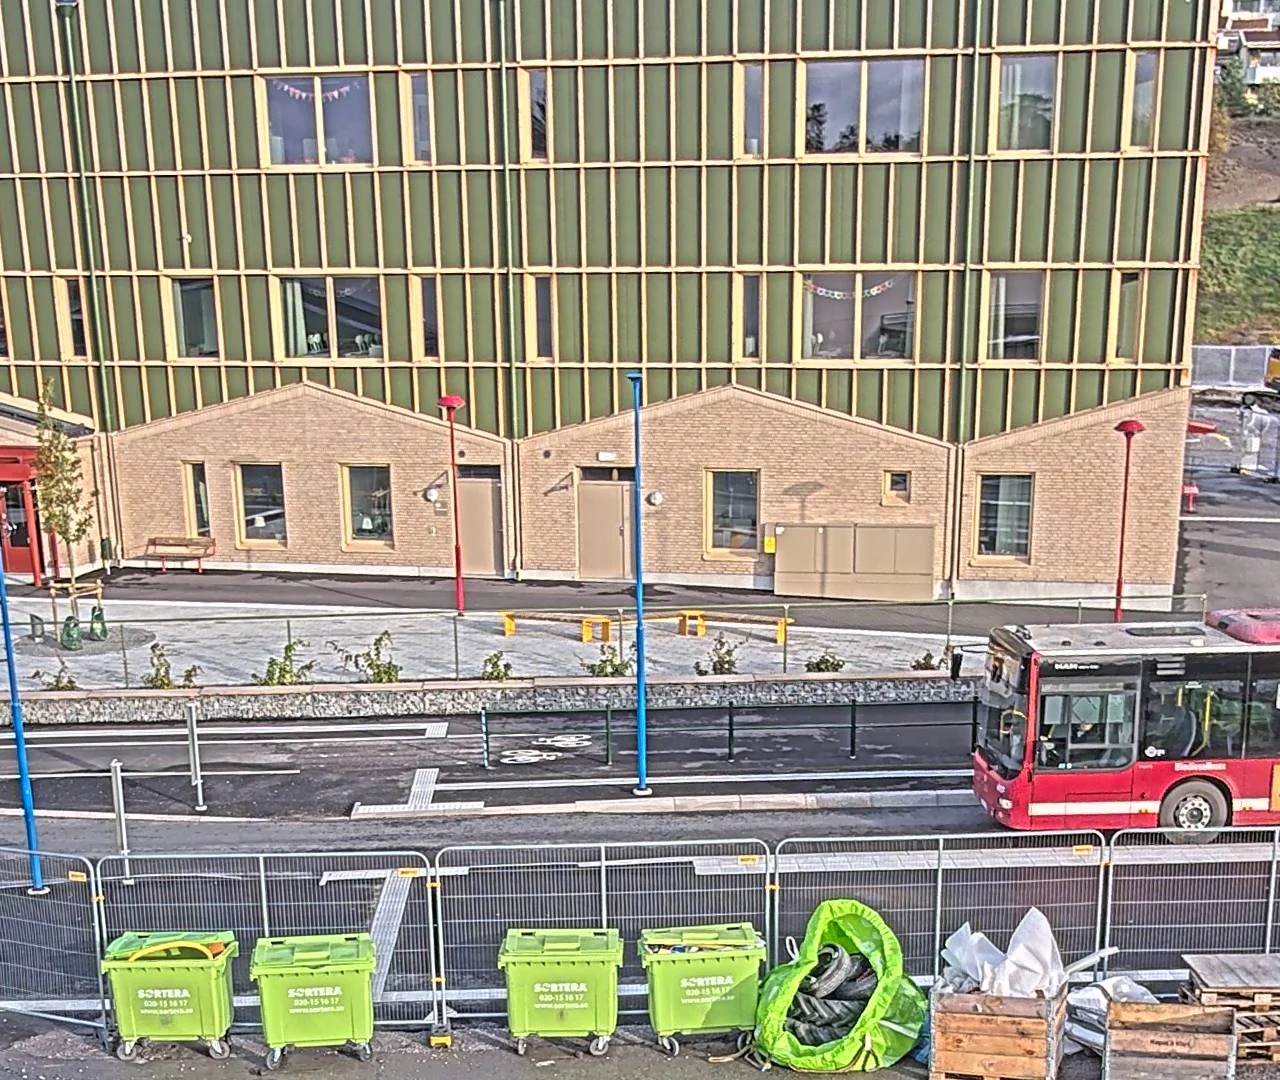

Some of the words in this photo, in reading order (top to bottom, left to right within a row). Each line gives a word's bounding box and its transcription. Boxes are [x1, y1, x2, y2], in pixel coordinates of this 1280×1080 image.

[680, 976, 734, 988] SORTERA
[137, 988, 191, 999] SORTERA
[287, 986, 343, 998] SORTERA
[533, 983, 588, 993] SORTERA
